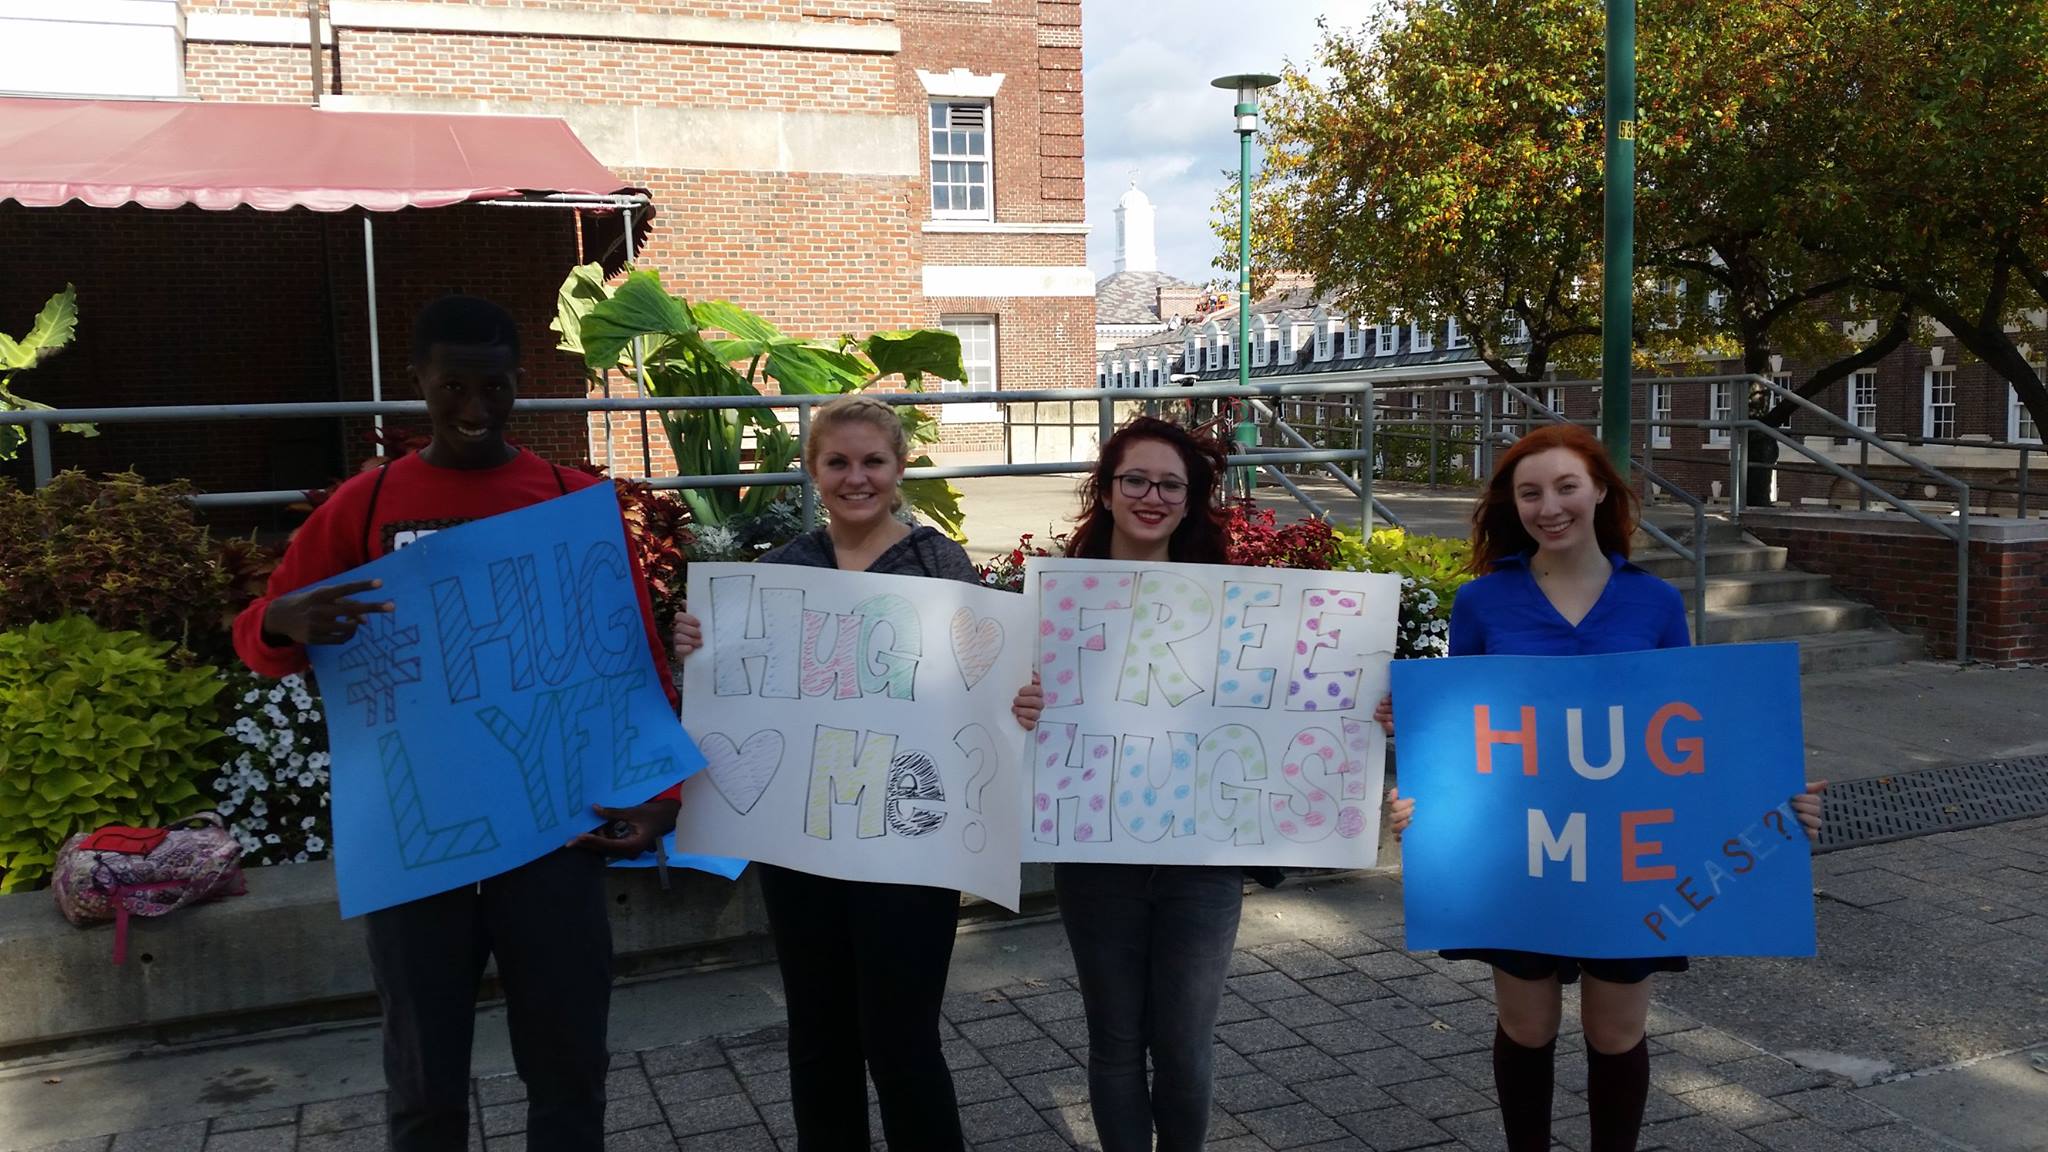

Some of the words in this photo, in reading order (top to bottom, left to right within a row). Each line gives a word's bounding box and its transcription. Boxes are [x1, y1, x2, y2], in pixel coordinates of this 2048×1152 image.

[1038, 571, 1366, 712] FREE
[1474, 702, 1705, 780] HUG
[1528, 808, 1676, 882] ME
